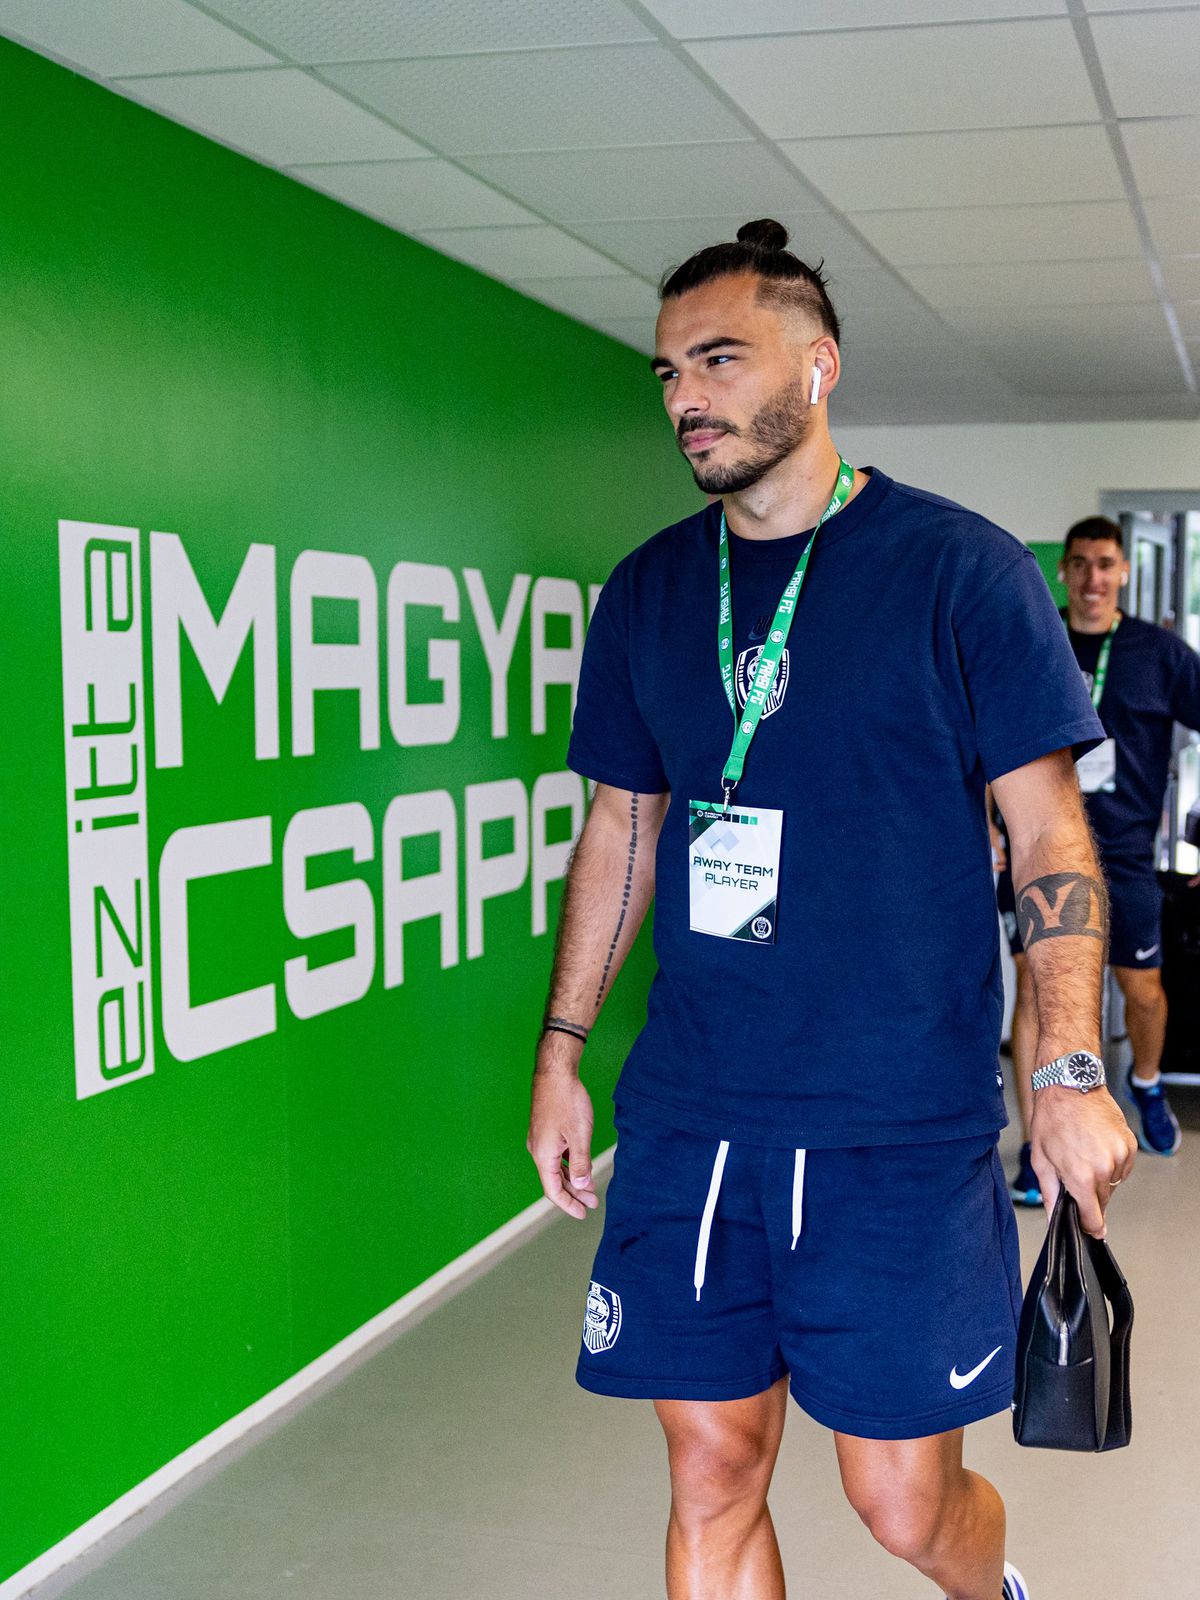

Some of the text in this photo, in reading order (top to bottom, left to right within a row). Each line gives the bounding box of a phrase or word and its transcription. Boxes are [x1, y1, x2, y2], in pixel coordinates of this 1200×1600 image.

[719, 582, 730, 625] PAKSI FC
[778, 570, 804, 615] PAKSI FC
[149, 530, 603, 769] MAGYA
[721, 664, 732, 681] FC
[755, 658, 777, 691] PAKSI
[749, 688, 767, 706] FC
[72, 537, 147, 1081] ez itt a
[693, 856, 774, 878] AWAY TEAM
[704, 873, 759, 891] PLAYER
[157, 768, 599, 1063] CSAPA
